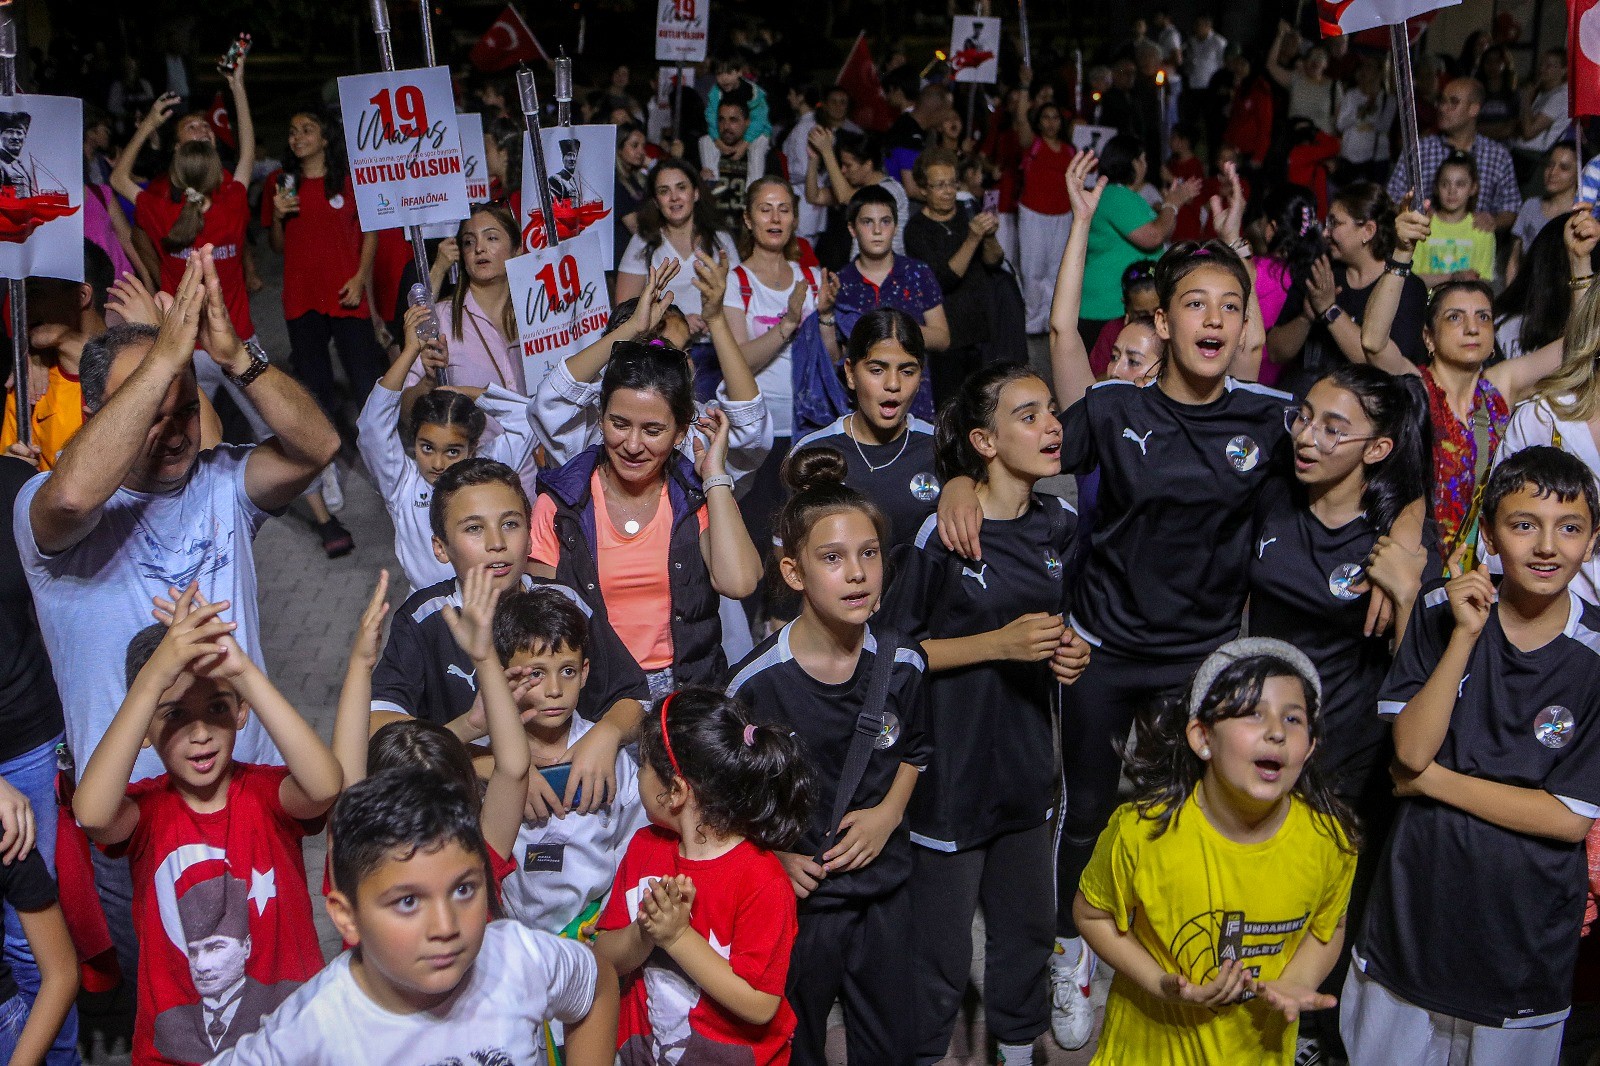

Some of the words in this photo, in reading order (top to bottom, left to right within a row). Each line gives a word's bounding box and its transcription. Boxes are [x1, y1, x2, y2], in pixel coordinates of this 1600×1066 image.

[672, 0, 695, 21] 19
[369, 85, 429, 140] 19
[357, 108, 447, 170] Mayıs
[354, 162, 406, 185] KUTLU
[410, 155, 461, 179] OLSUN
[401, 195, 425, 208] İRFAN
[426, 192, 449, 203] ÖNAL
[526, 281, 597, 334] Mayıs
[534, 254, 581, 312] 19
[523, 329, 570, 357] KUTLU
[572, 311, 609, 342] OLSUN
